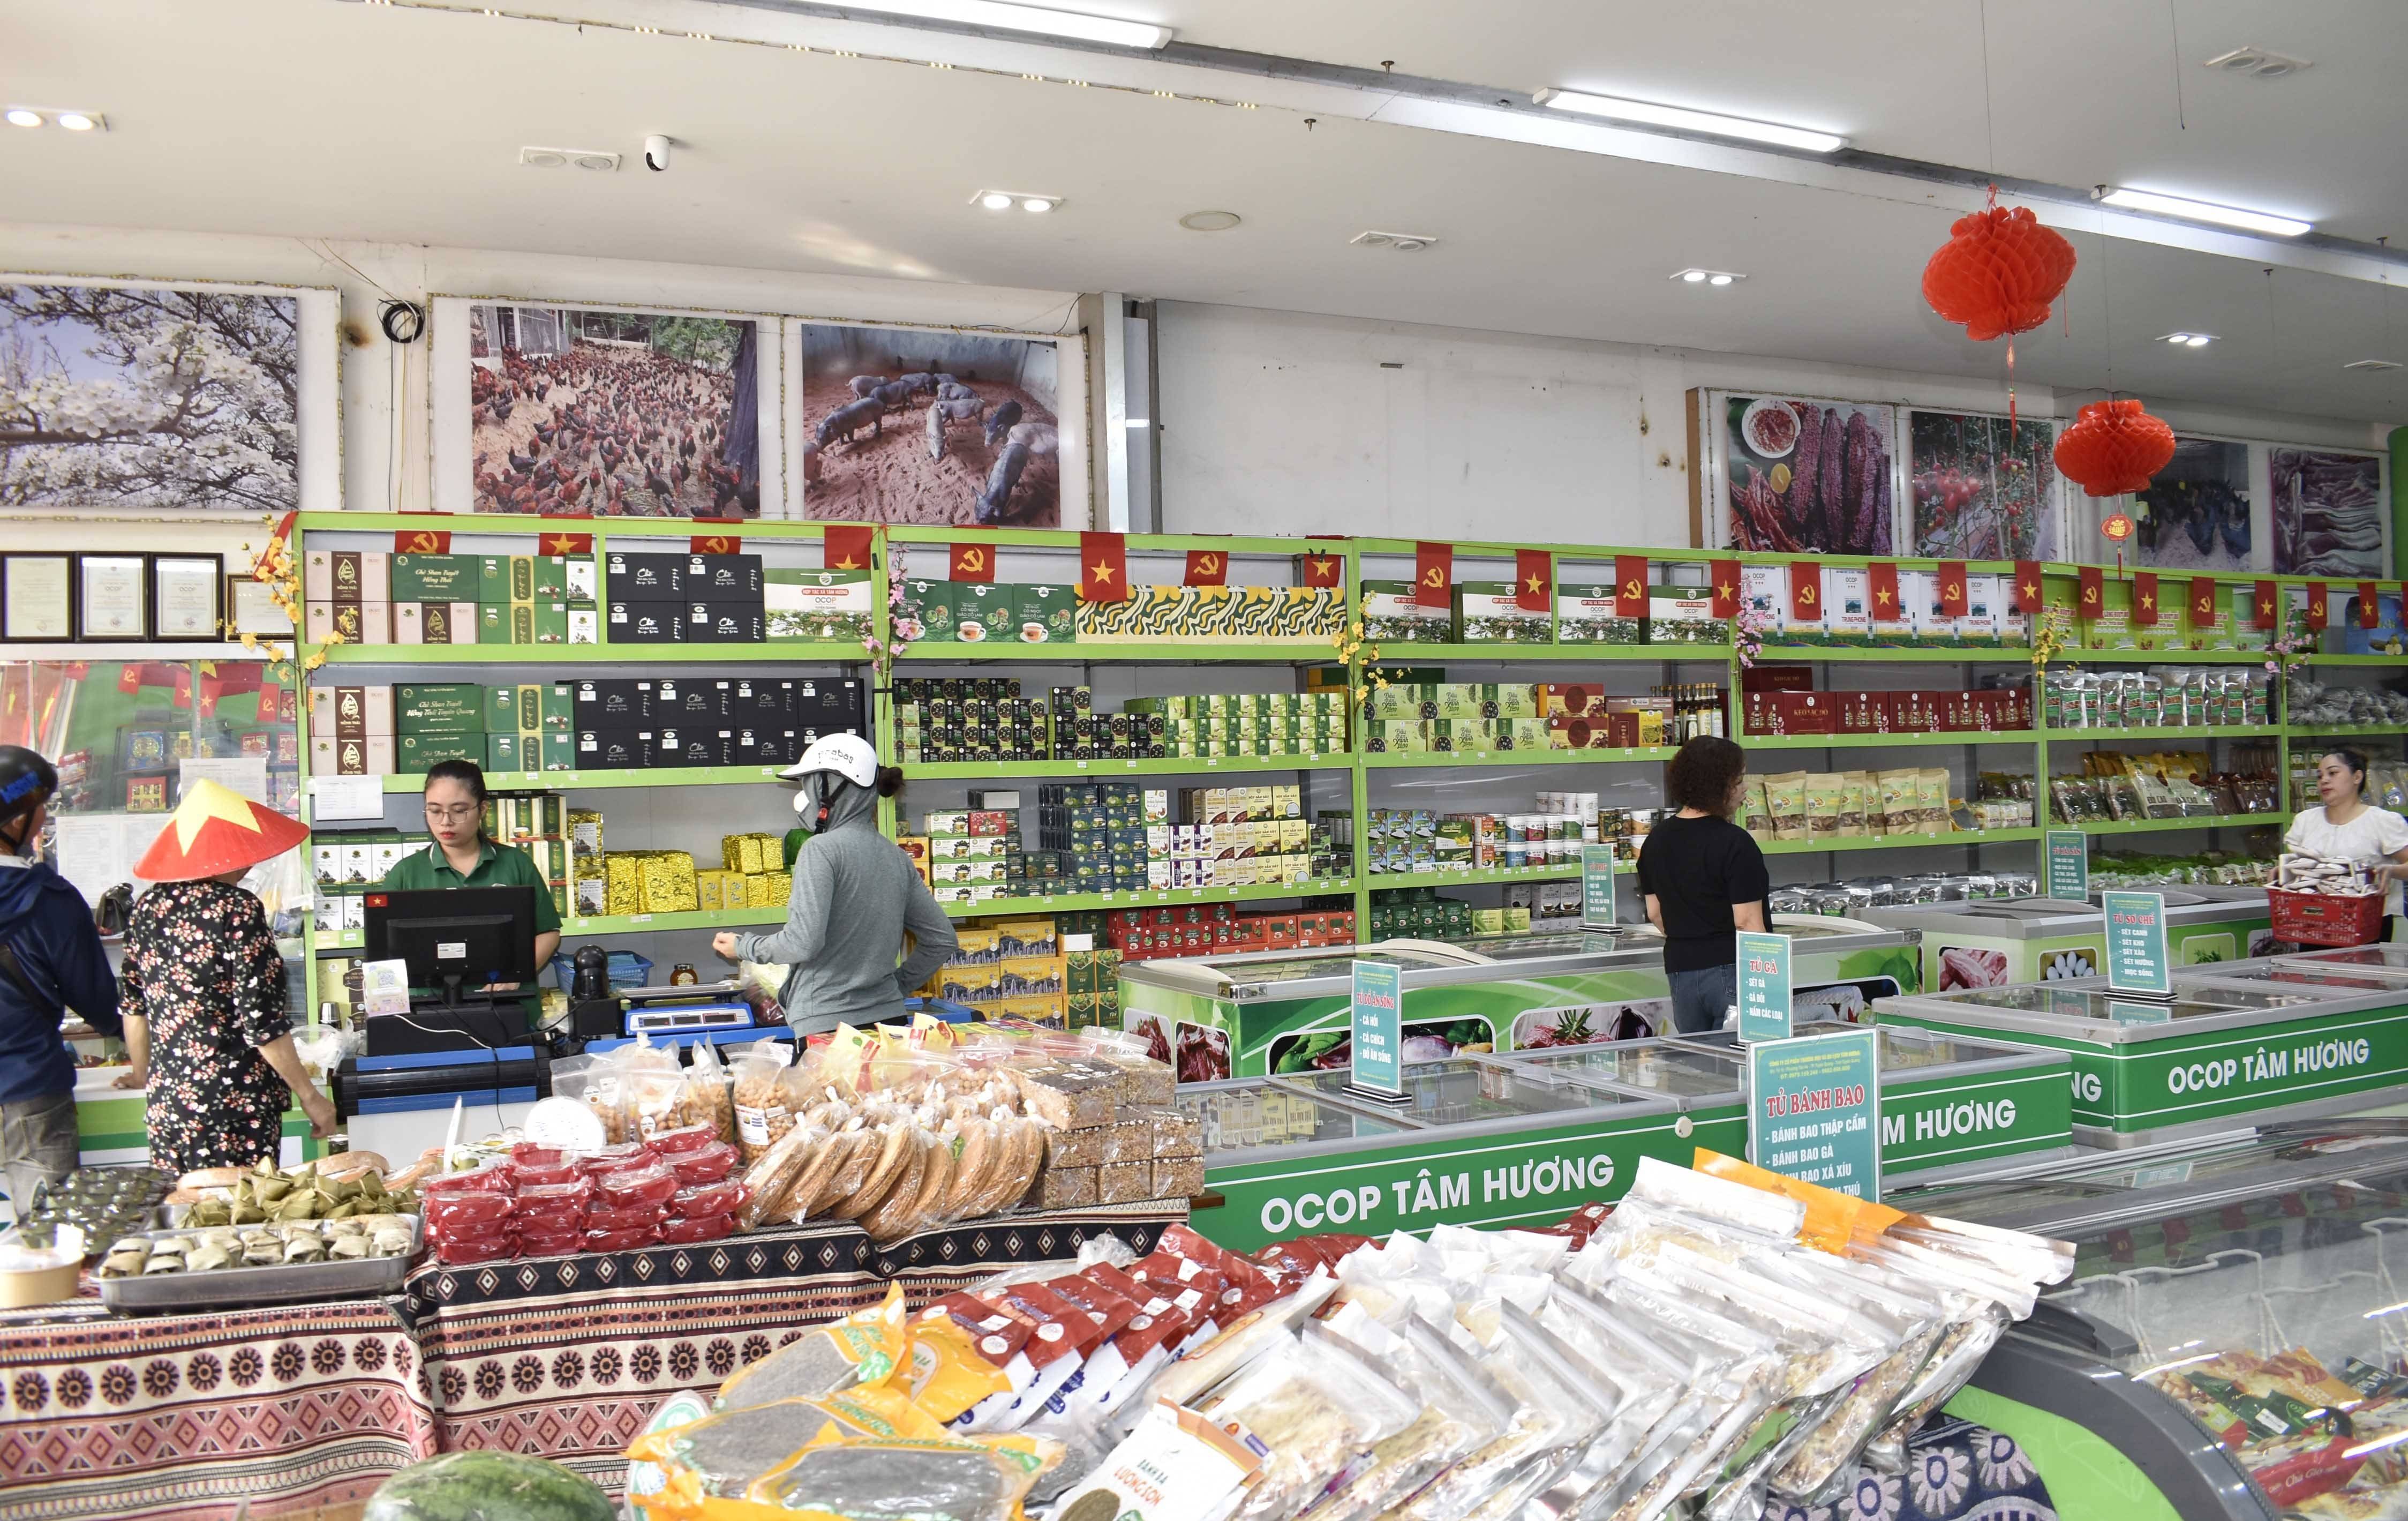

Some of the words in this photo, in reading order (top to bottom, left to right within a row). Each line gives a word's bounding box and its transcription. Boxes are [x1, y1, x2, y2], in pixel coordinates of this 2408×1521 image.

[2113, 910, 2124, 924] TỦ
[1749, 956, 1762, 972] TỦ
[1764, 959, 1778, 974] GÀ
[1356, 988, 1363, 1005] TỦ
[1364, 988, 1372, 1006] ĐỒ
[1380, 991, 1395, 1010] SỐNG
[1749, 992, 1756, 1003] GÀ
[1363, 1015, 1369, 1026] CÁ
[1762, 1007, 1771, 1018] CÁC
[1772, 1010, 1783, 1022] LOẠI
[1363, 1033, 1369, 1043] CÁ
[2168, 1058, 2237, 1095] OCOP
[2242, 1046, 2287, 1083] TÂM
[2293, 1038, 2370, 1075] HƯƠNG
[1766, 1087, 1787, 1118] TỦ
[1790, 1086, 1831, 1114] BÁNH
[1834, 1084, 1864, 1108] BAO
[1772, 1127, 1797, 1143] BÁNH
[1800, 1125, 1818, 1139] BAO
[1820, 1119, 1843, 1137] THẬP
[1846, 1113, 1867, 1132] CẨM
[1915, 1098, 2017, 1141] HƯƠNG
[1772, 1150, 1797, 1166] BÁNH
[1801, 1147, 1818, 1162] BAO
[1821, 1142, 1834, 1159] GÀ
[1801, 1168, 1819, 1183] BAO
[1822, 1164, 1834, 1180] XÁ
[1837, 1162, 1852, 1178] XÍU
[1261, 1186, 1380, 1233] OCOP
[1393, 1168, 1469, 1214] TÂM
[1484, 1154, 1614, 1202] HƯƠNG
[1843, 1181, 1860, 1196] THÚ
